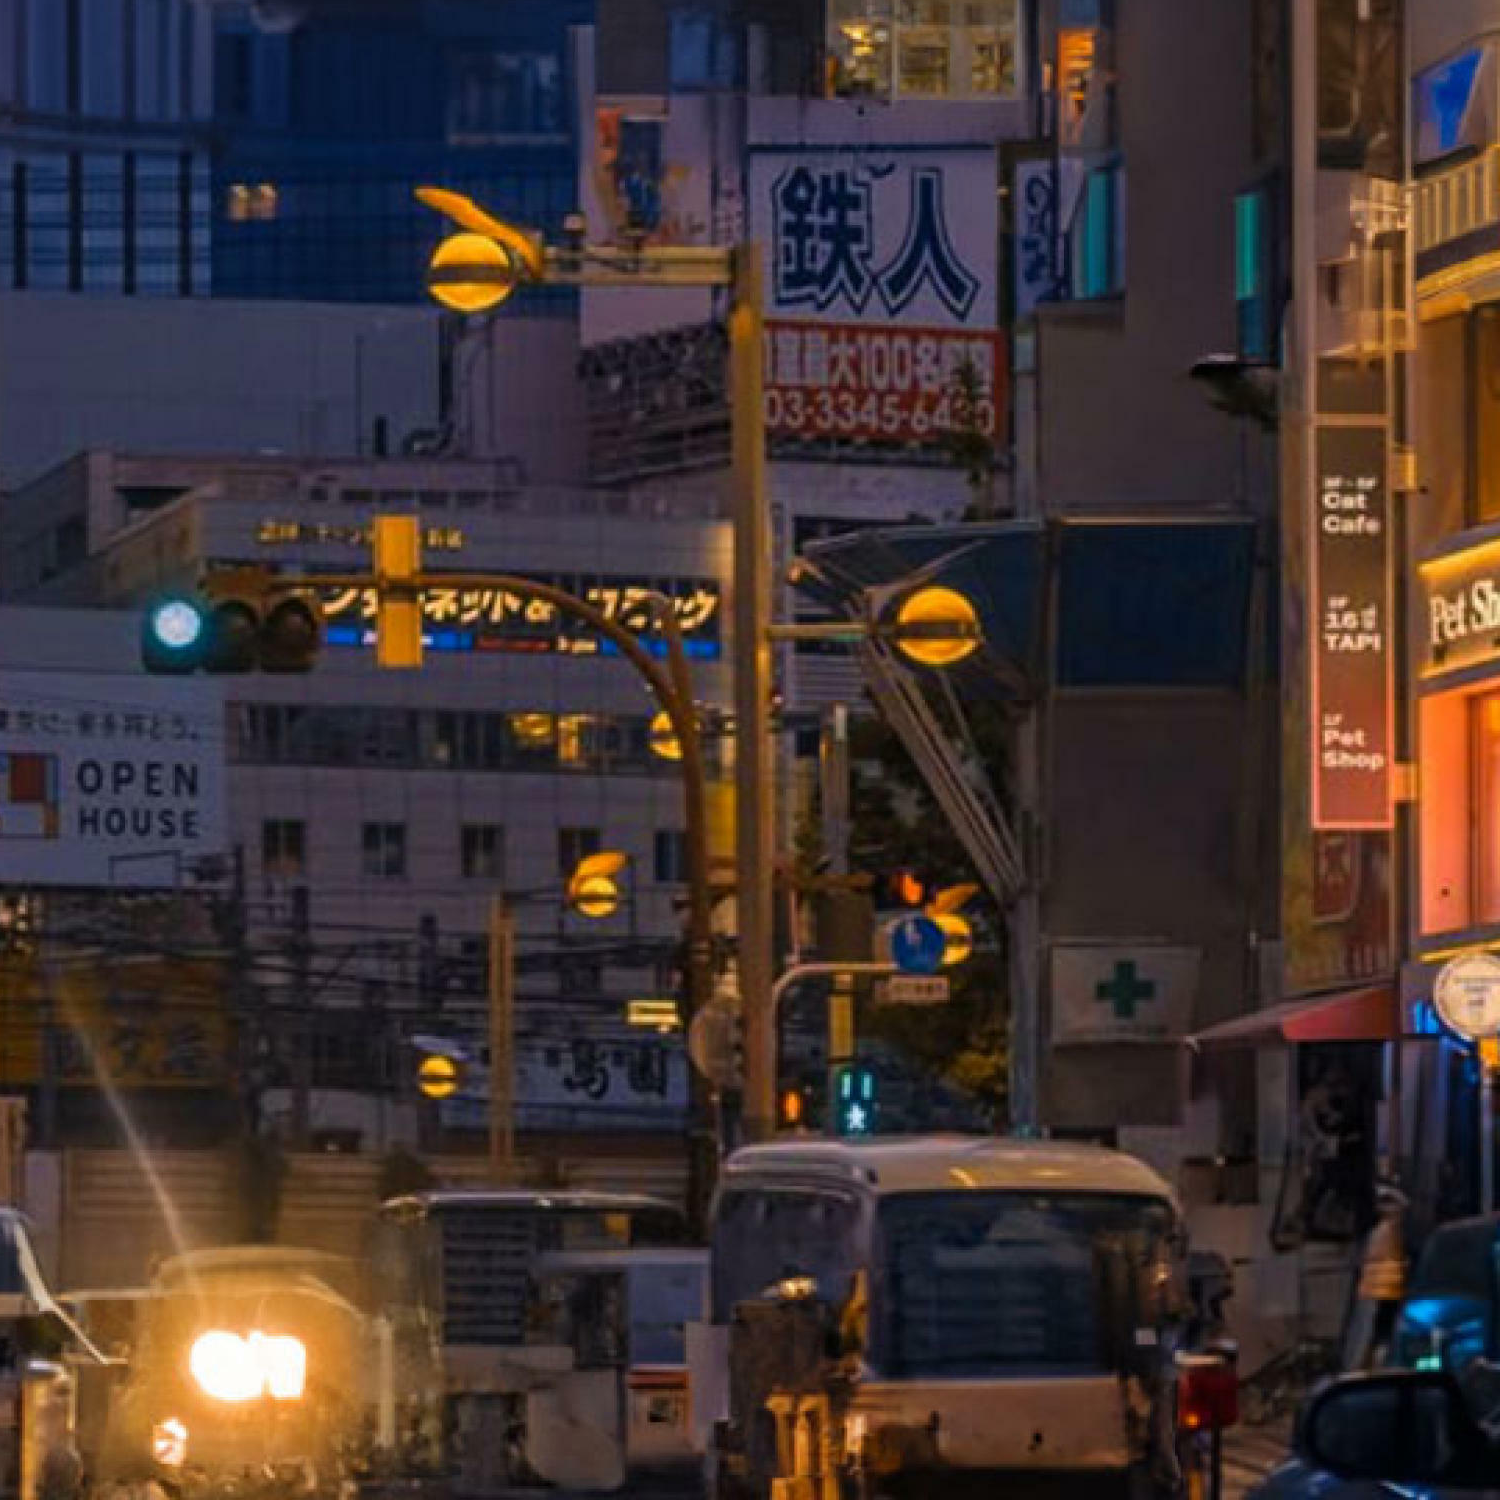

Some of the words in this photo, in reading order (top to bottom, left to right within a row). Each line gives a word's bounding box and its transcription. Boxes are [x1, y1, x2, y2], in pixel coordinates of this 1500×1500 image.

[1430, 593, 1468, 644] Pet
[76, 759, 199, 798] OPEN
[78, 807, 200, 839] HOUSE
